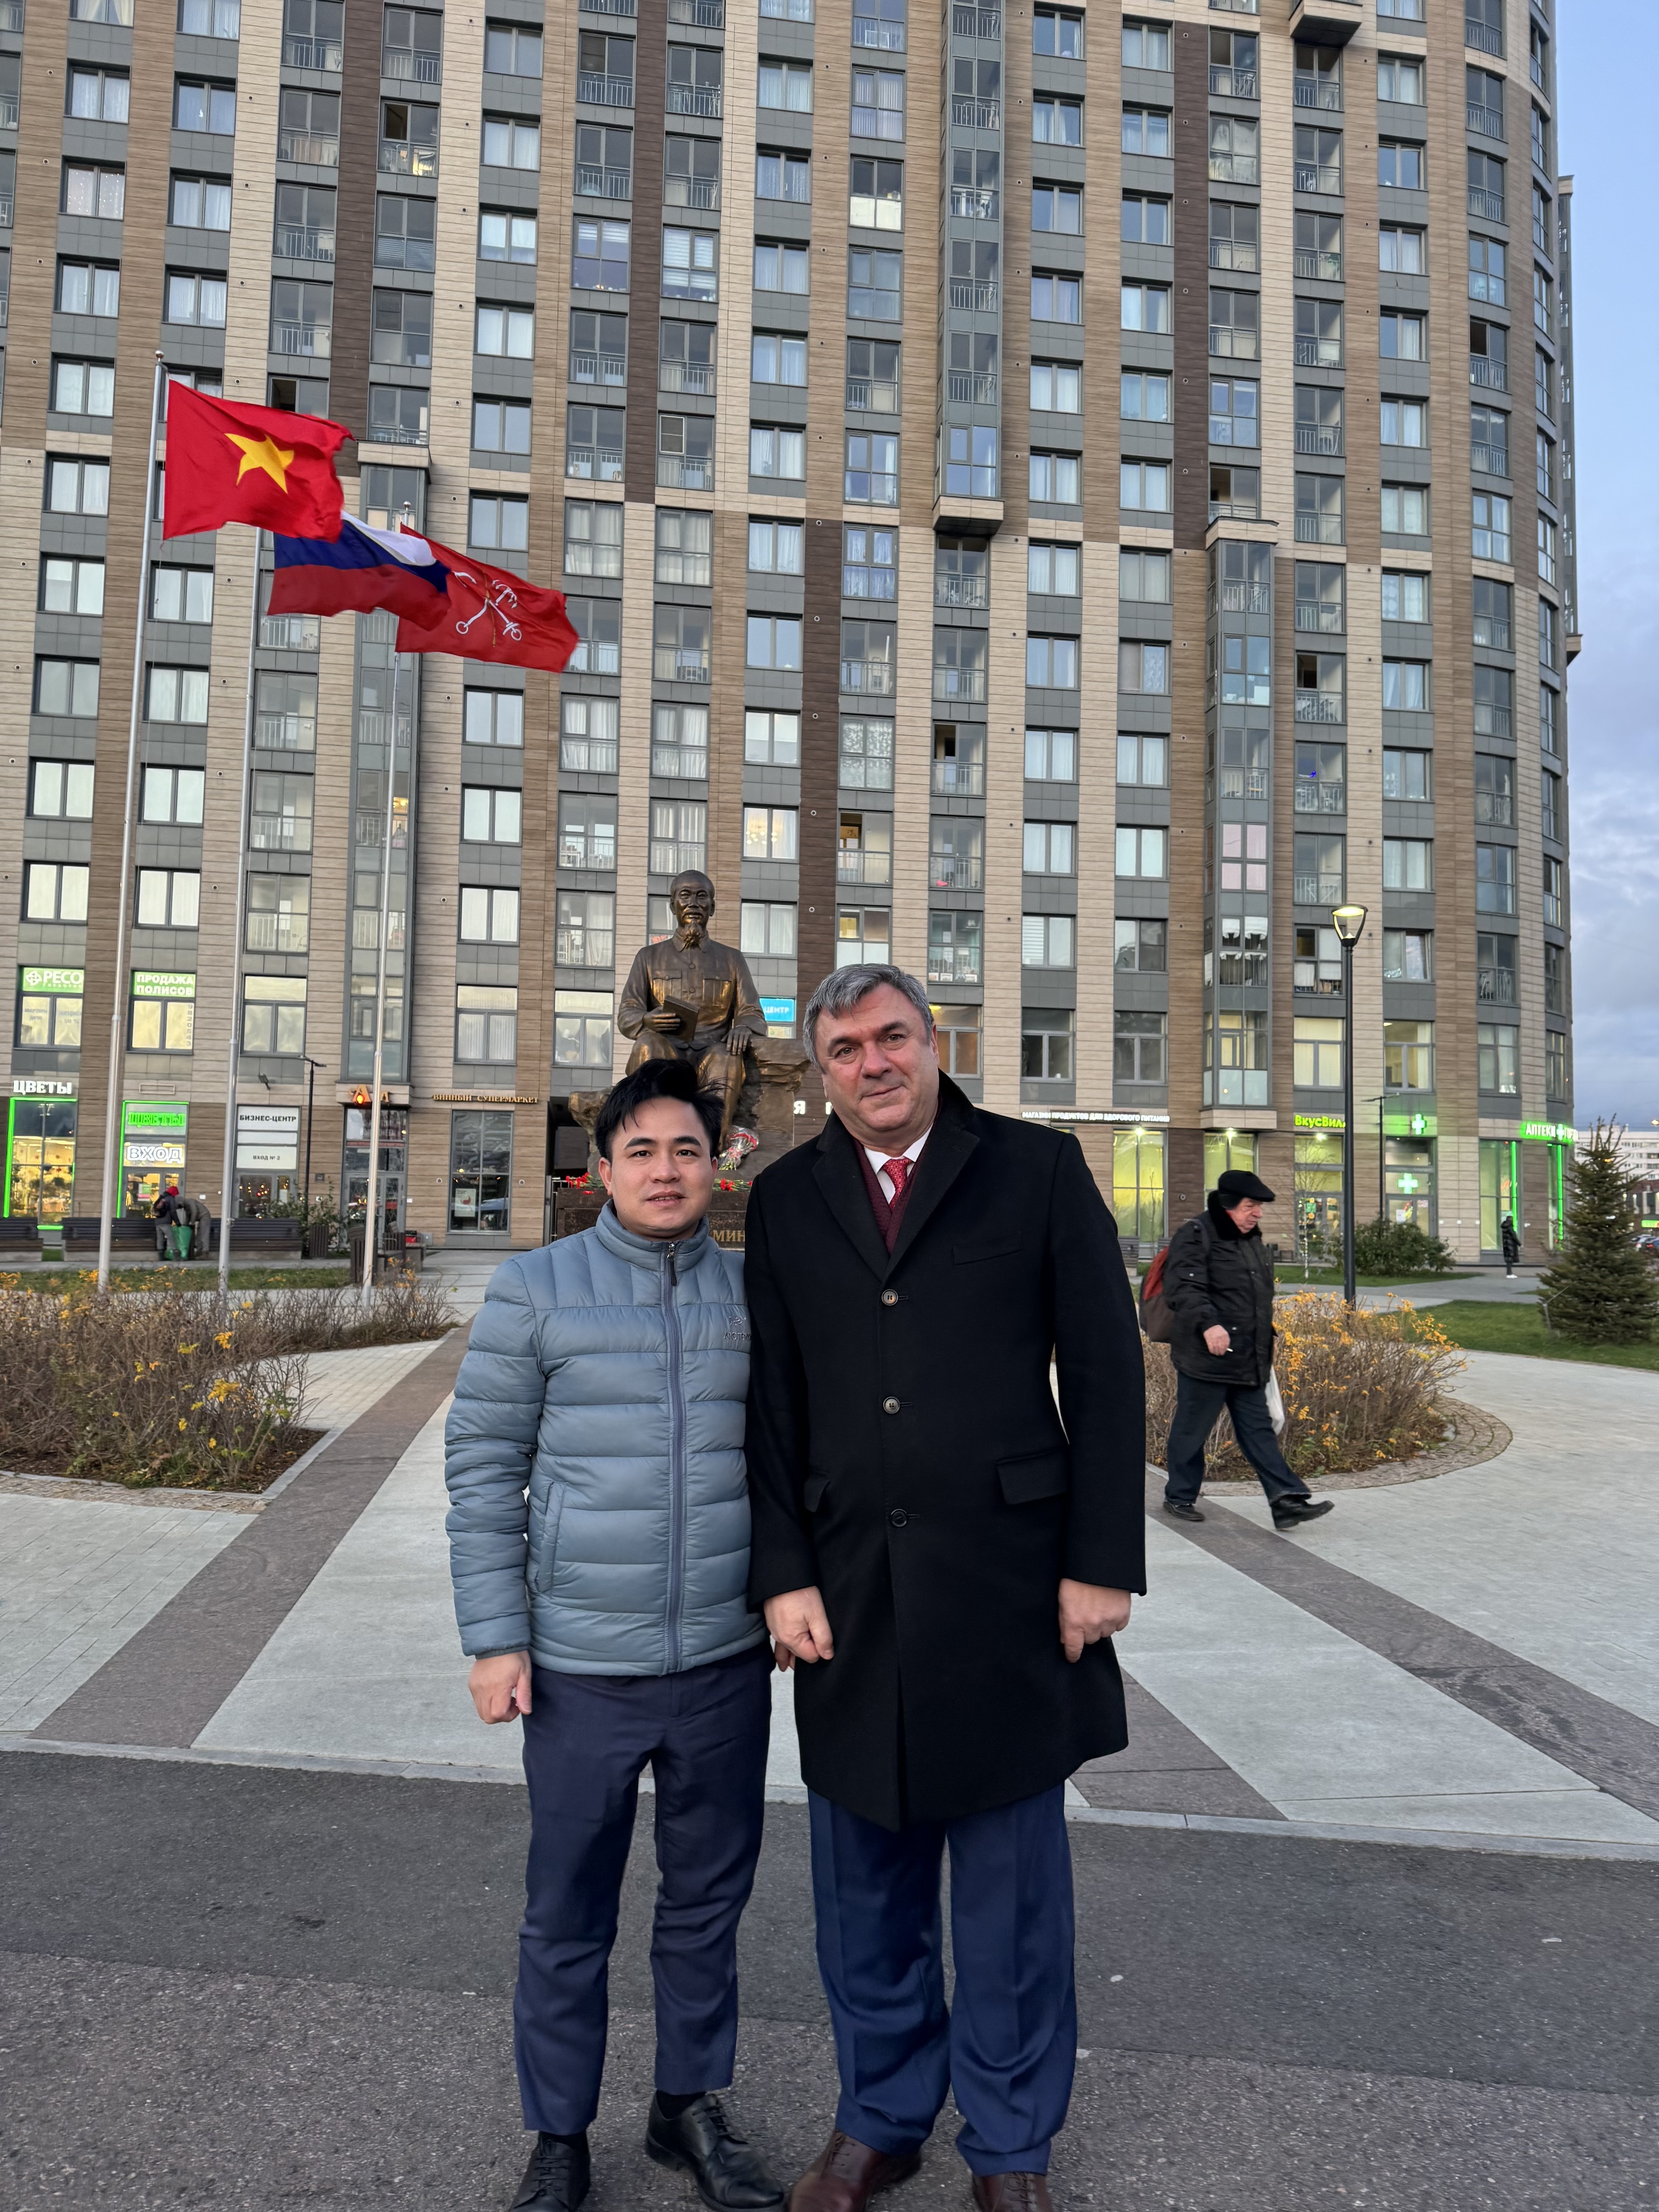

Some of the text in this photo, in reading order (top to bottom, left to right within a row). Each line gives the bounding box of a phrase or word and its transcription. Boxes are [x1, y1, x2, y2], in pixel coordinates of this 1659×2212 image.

[137, 974, 193, 985] ПРОДАЖА
[136, 985, 193, 995] ПОЛИСОВ
[13, 1080, 72, 1095] ЦВЕТЫ
[128, 1112, 185, 1128] ЦВЕТЫ
[1104, 1113, 1140, 1121] ЗДОРОВОГО
[1525, 1123, 1556, 1137] АПТЕКИ
[127, 1146, 184, 1164] ВХОД
